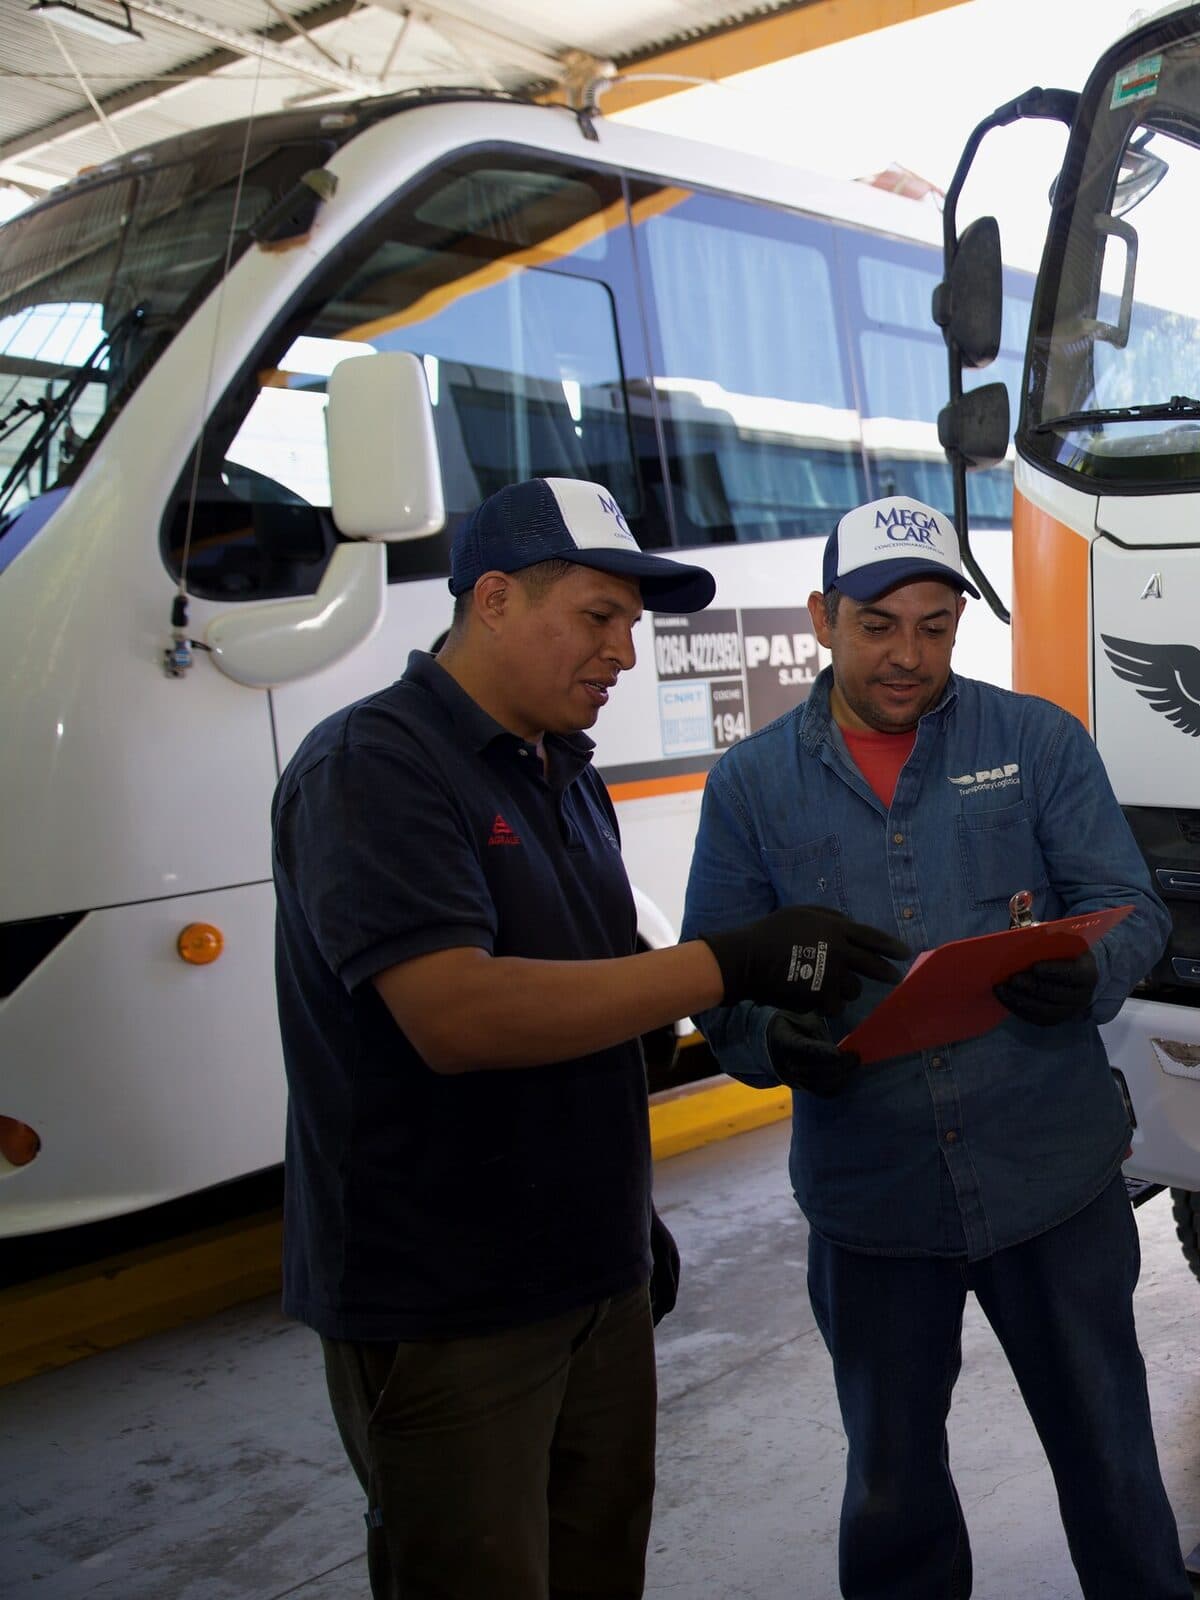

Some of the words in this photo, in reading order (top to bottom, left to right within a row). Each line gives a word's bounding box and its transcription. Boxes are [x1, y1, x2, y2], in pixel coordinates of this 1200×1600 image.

[875, 507, 941, 536] MEGA
[886, 524, 936, 546] CAR
[744, 633, 817, 668] PAP
[713, 711, 745, 743] 194
[976, 763, 1019, 783] PAP
